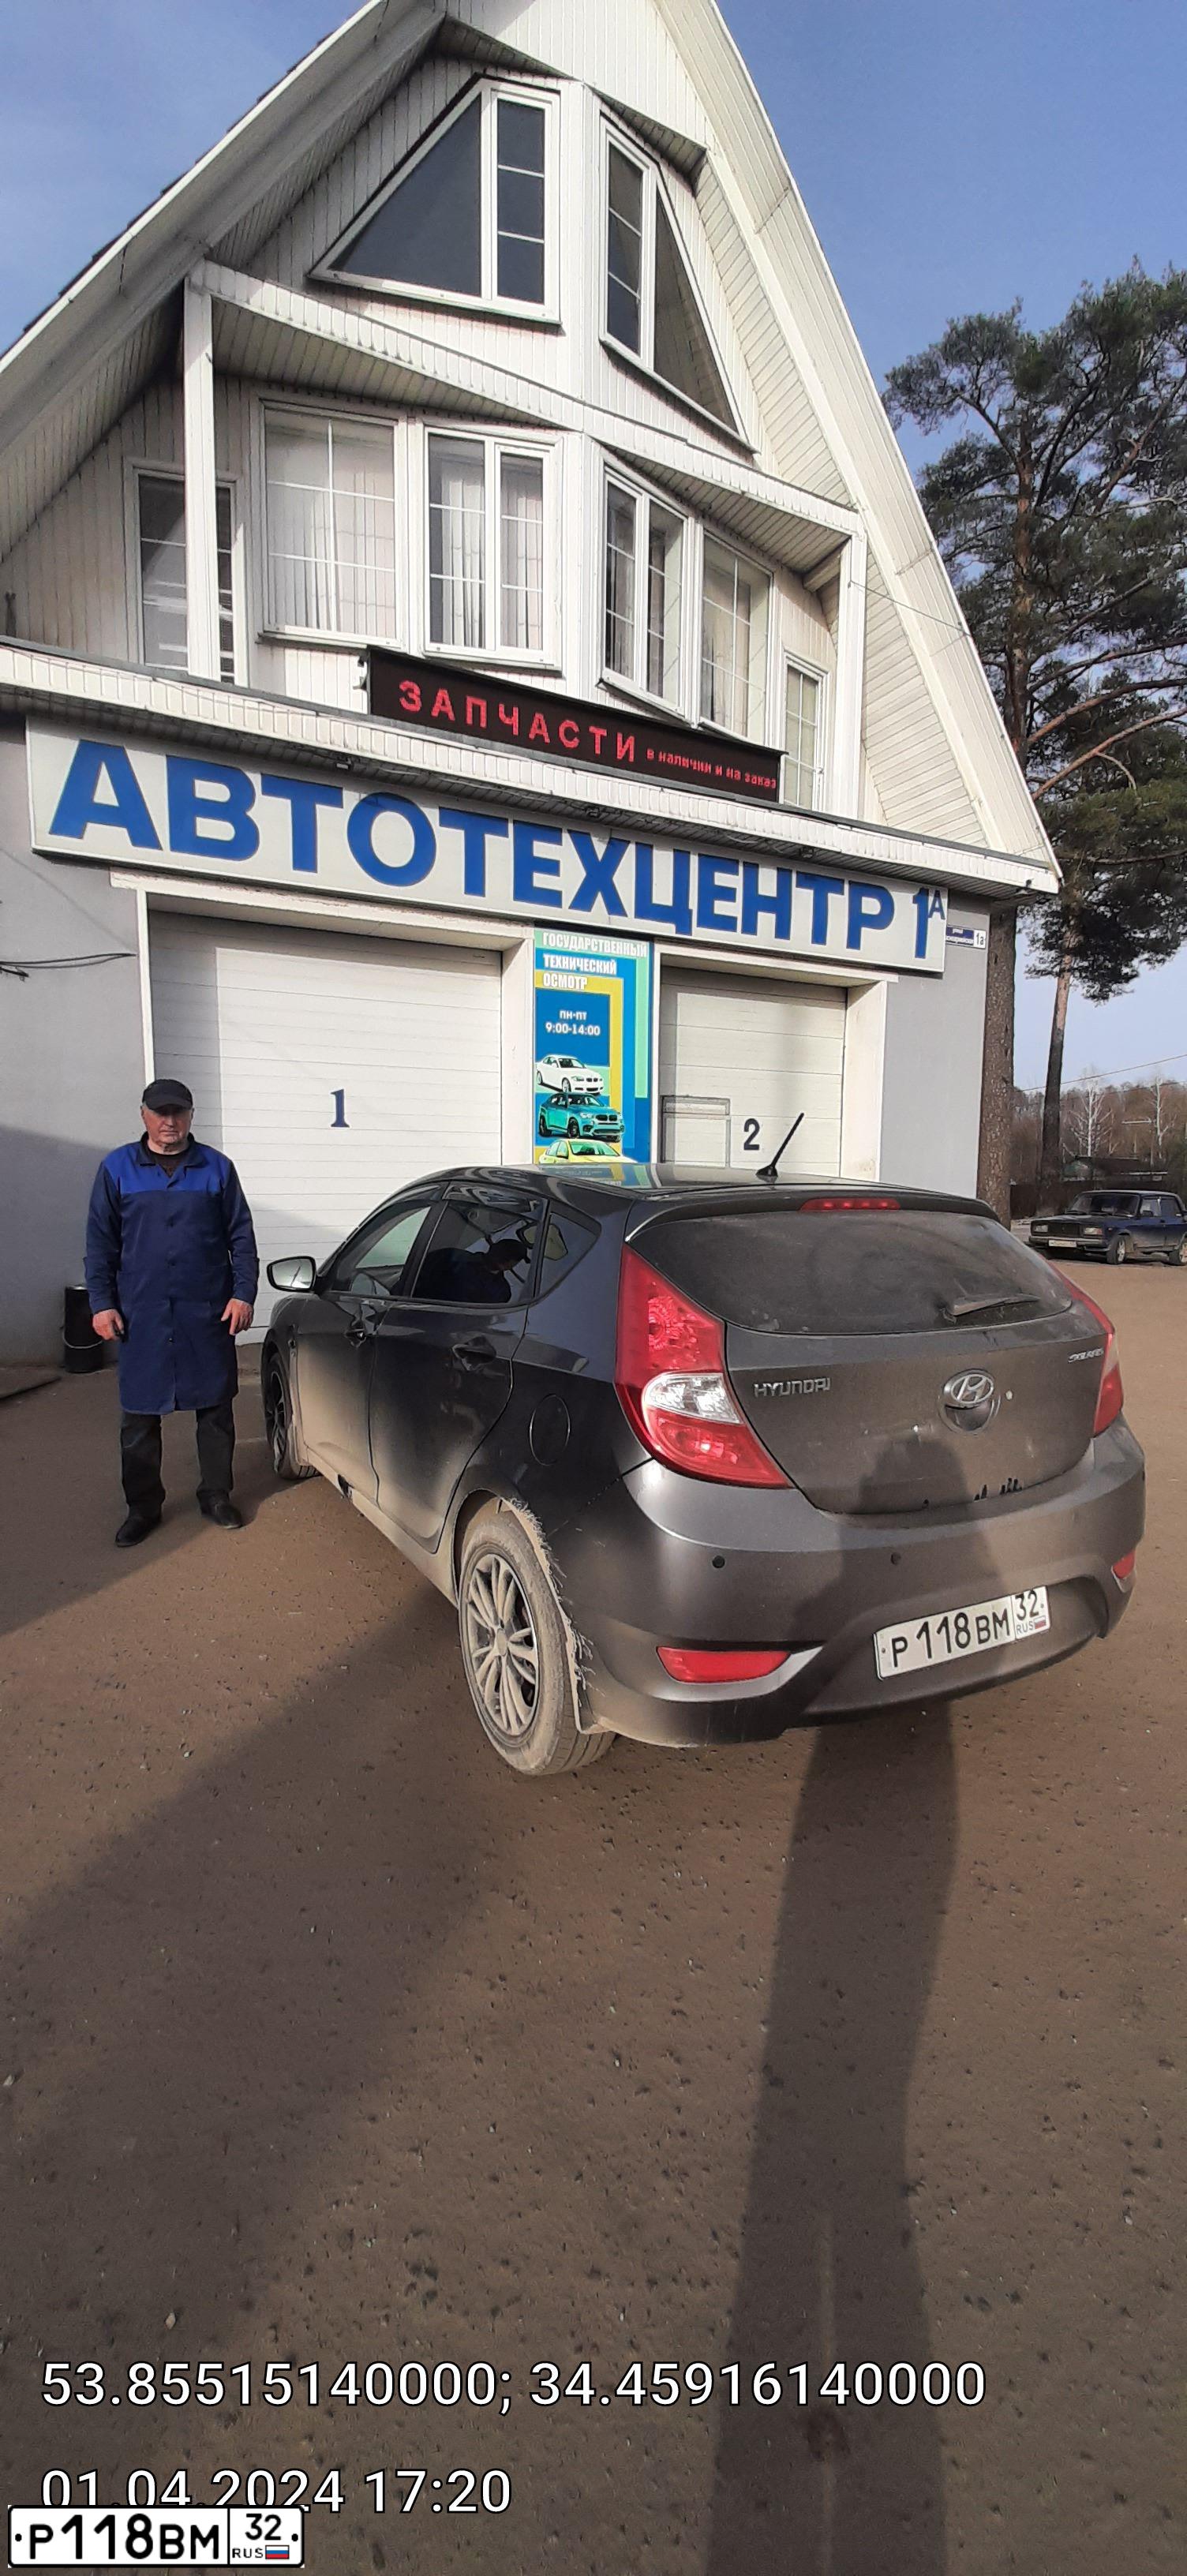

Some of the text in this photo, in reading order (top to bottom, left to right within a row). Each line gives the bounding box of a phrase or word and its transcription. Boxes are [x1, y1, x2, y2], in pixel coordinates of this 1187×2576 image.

[399, 680, 635, 762] ЗАПЧАСТИ
[48, 739, 895, 951] АВТОТЕХЦЕНТР
[542, 931, 647, 957] ГОСУДАРСТВЕННЫЙ
[542, 953, 617, 975] ТЕХНИЧЕСКИЙ
[542, 972, 588, 990] ОСМОТР
[545, 1021, 601, 1036] 9:00-14:00
[330, 1088, 350, 1129] 1
[743, 1118, 760, 1151] 2
[754, 1377, 831, 1398] HYUNDAI
[1016, 1622, 1034, 1634] RUS
